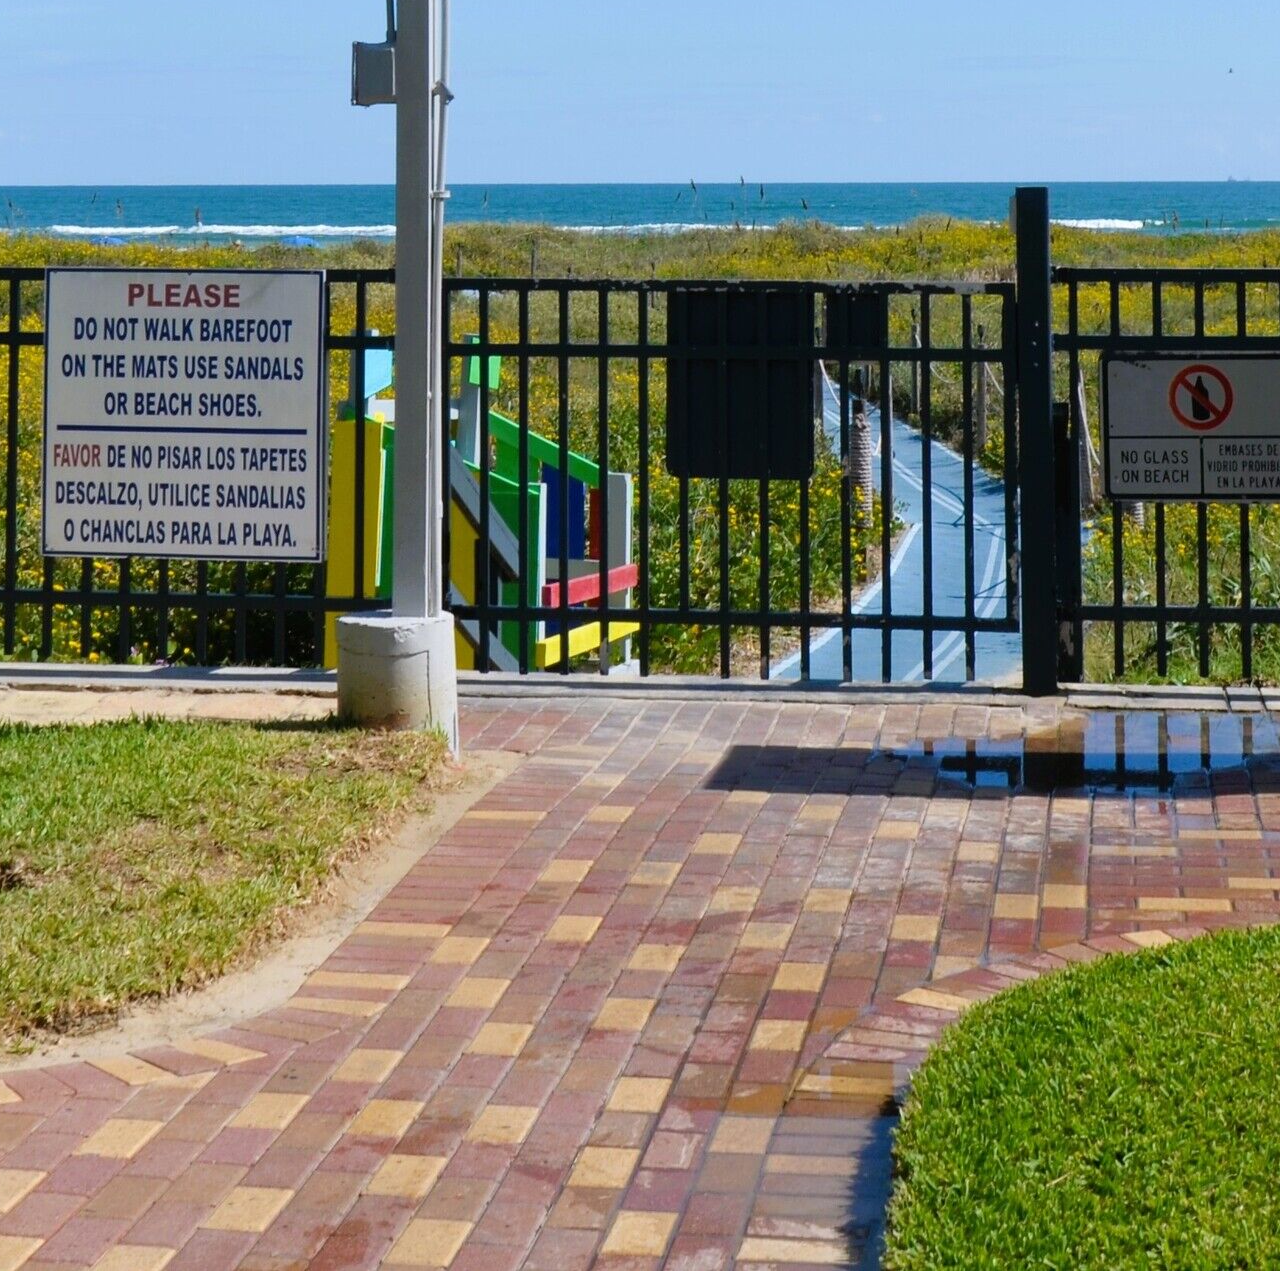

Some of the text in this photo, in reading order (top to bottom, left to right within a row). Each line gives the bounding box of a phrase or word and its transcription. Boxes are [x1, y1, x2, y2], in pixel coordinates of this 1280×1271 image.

[127, 283, 240, 308] PLEASE
[74, 317, 292, 342] DO NOT WALK BAREFOOT
[62, 354, 304, 380] ON THE MATS USE SANDALS
[104, 392, 262, 417] OR BEACH SHOES.
[53, 444, 307, 472] FAVOR DE NO PISAR LOS TAPETES
[1121, 451, 1188, 464] NO GLASS
[1219, 444, 1278, 456] EMBASES DE
[1122, 470, 1188, 483] ON BEACH
[1207, 461, 1238, 472] VIDRIO
[1217, 477, 1280, 488] EN LA PLAYA
[55, 481, 305, 510] DESCALZO, UTILICE SANDALIAS
[64, 519, 296, 547] O CHANCLAS PARA LA PLAYA.
